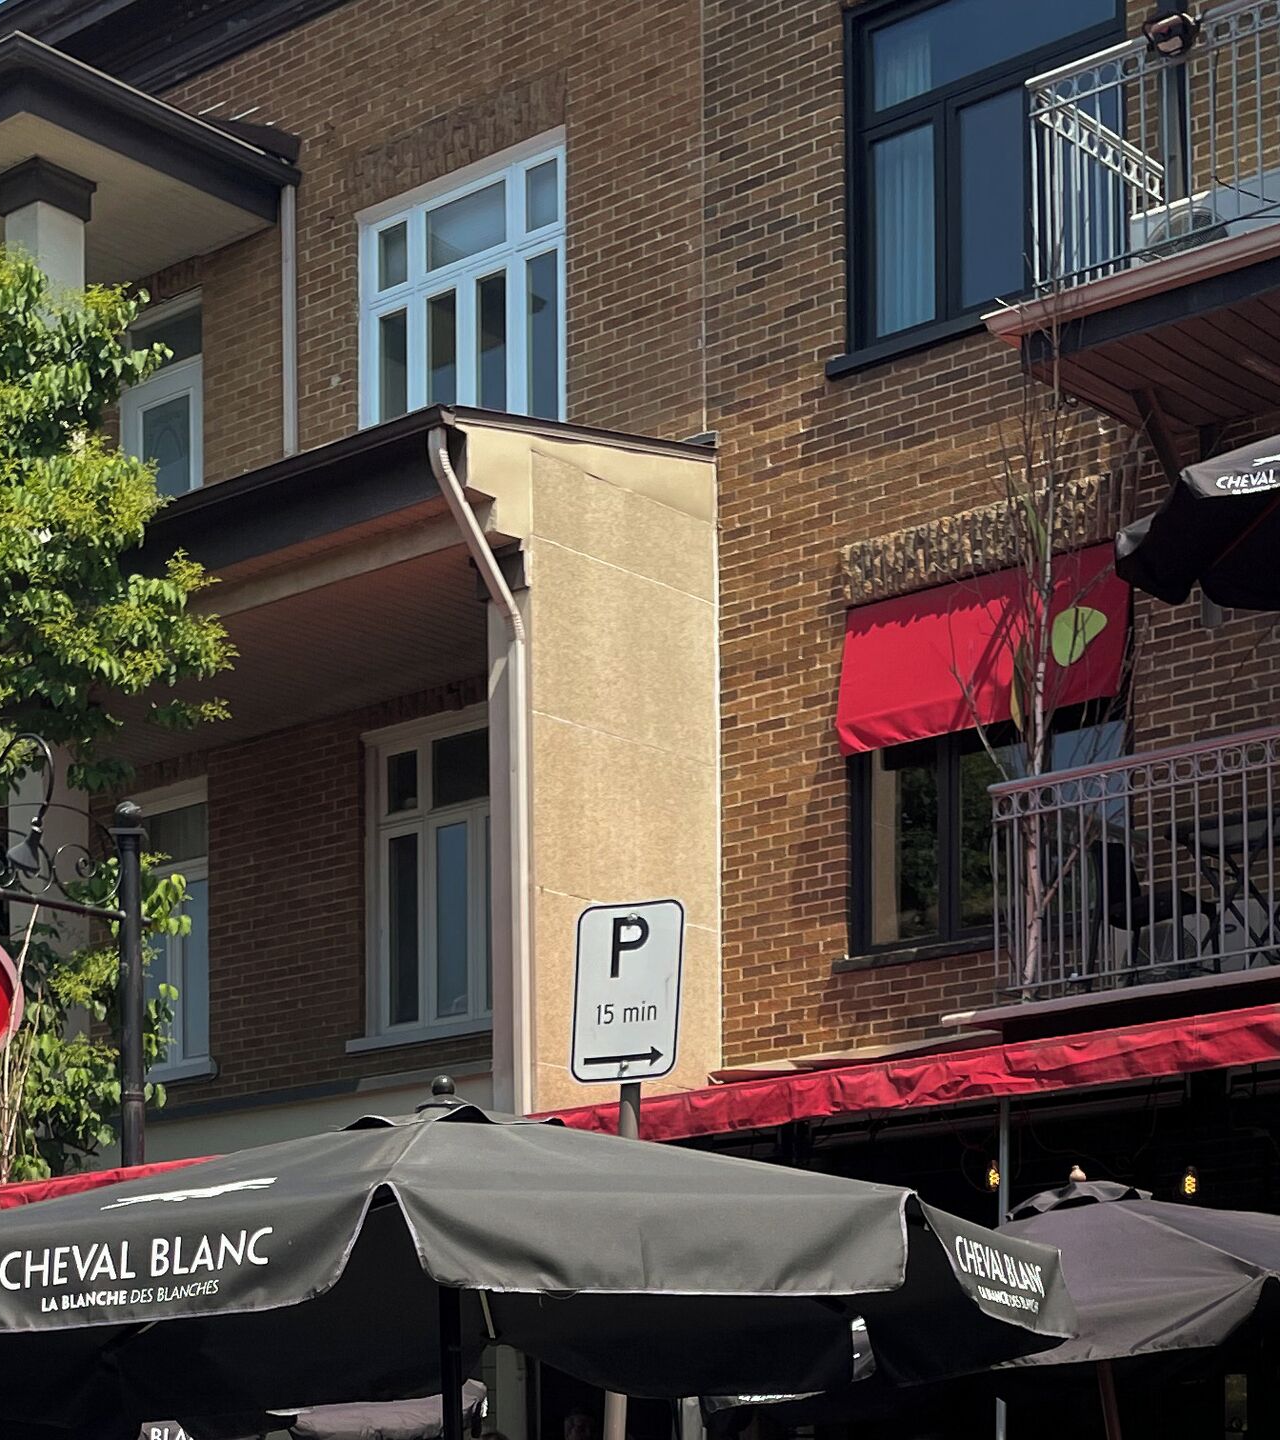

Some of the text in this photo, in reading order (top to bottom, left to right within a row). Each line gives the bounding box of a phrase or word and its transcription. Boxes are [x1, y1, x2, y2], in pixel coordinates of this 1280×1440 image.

[1215, 468, 1278, 490] CHEVAL
[610, 916, 650, 979] P
[596, 1000, 658, 1026] 15 min
[0, 1226, 274, 1291] CHEVAL BLANC
[955, 1235, 1008, 1285] CHEVAL
[41, 1279, 221, 1313] LA BLANCHE DES BLANCHES
